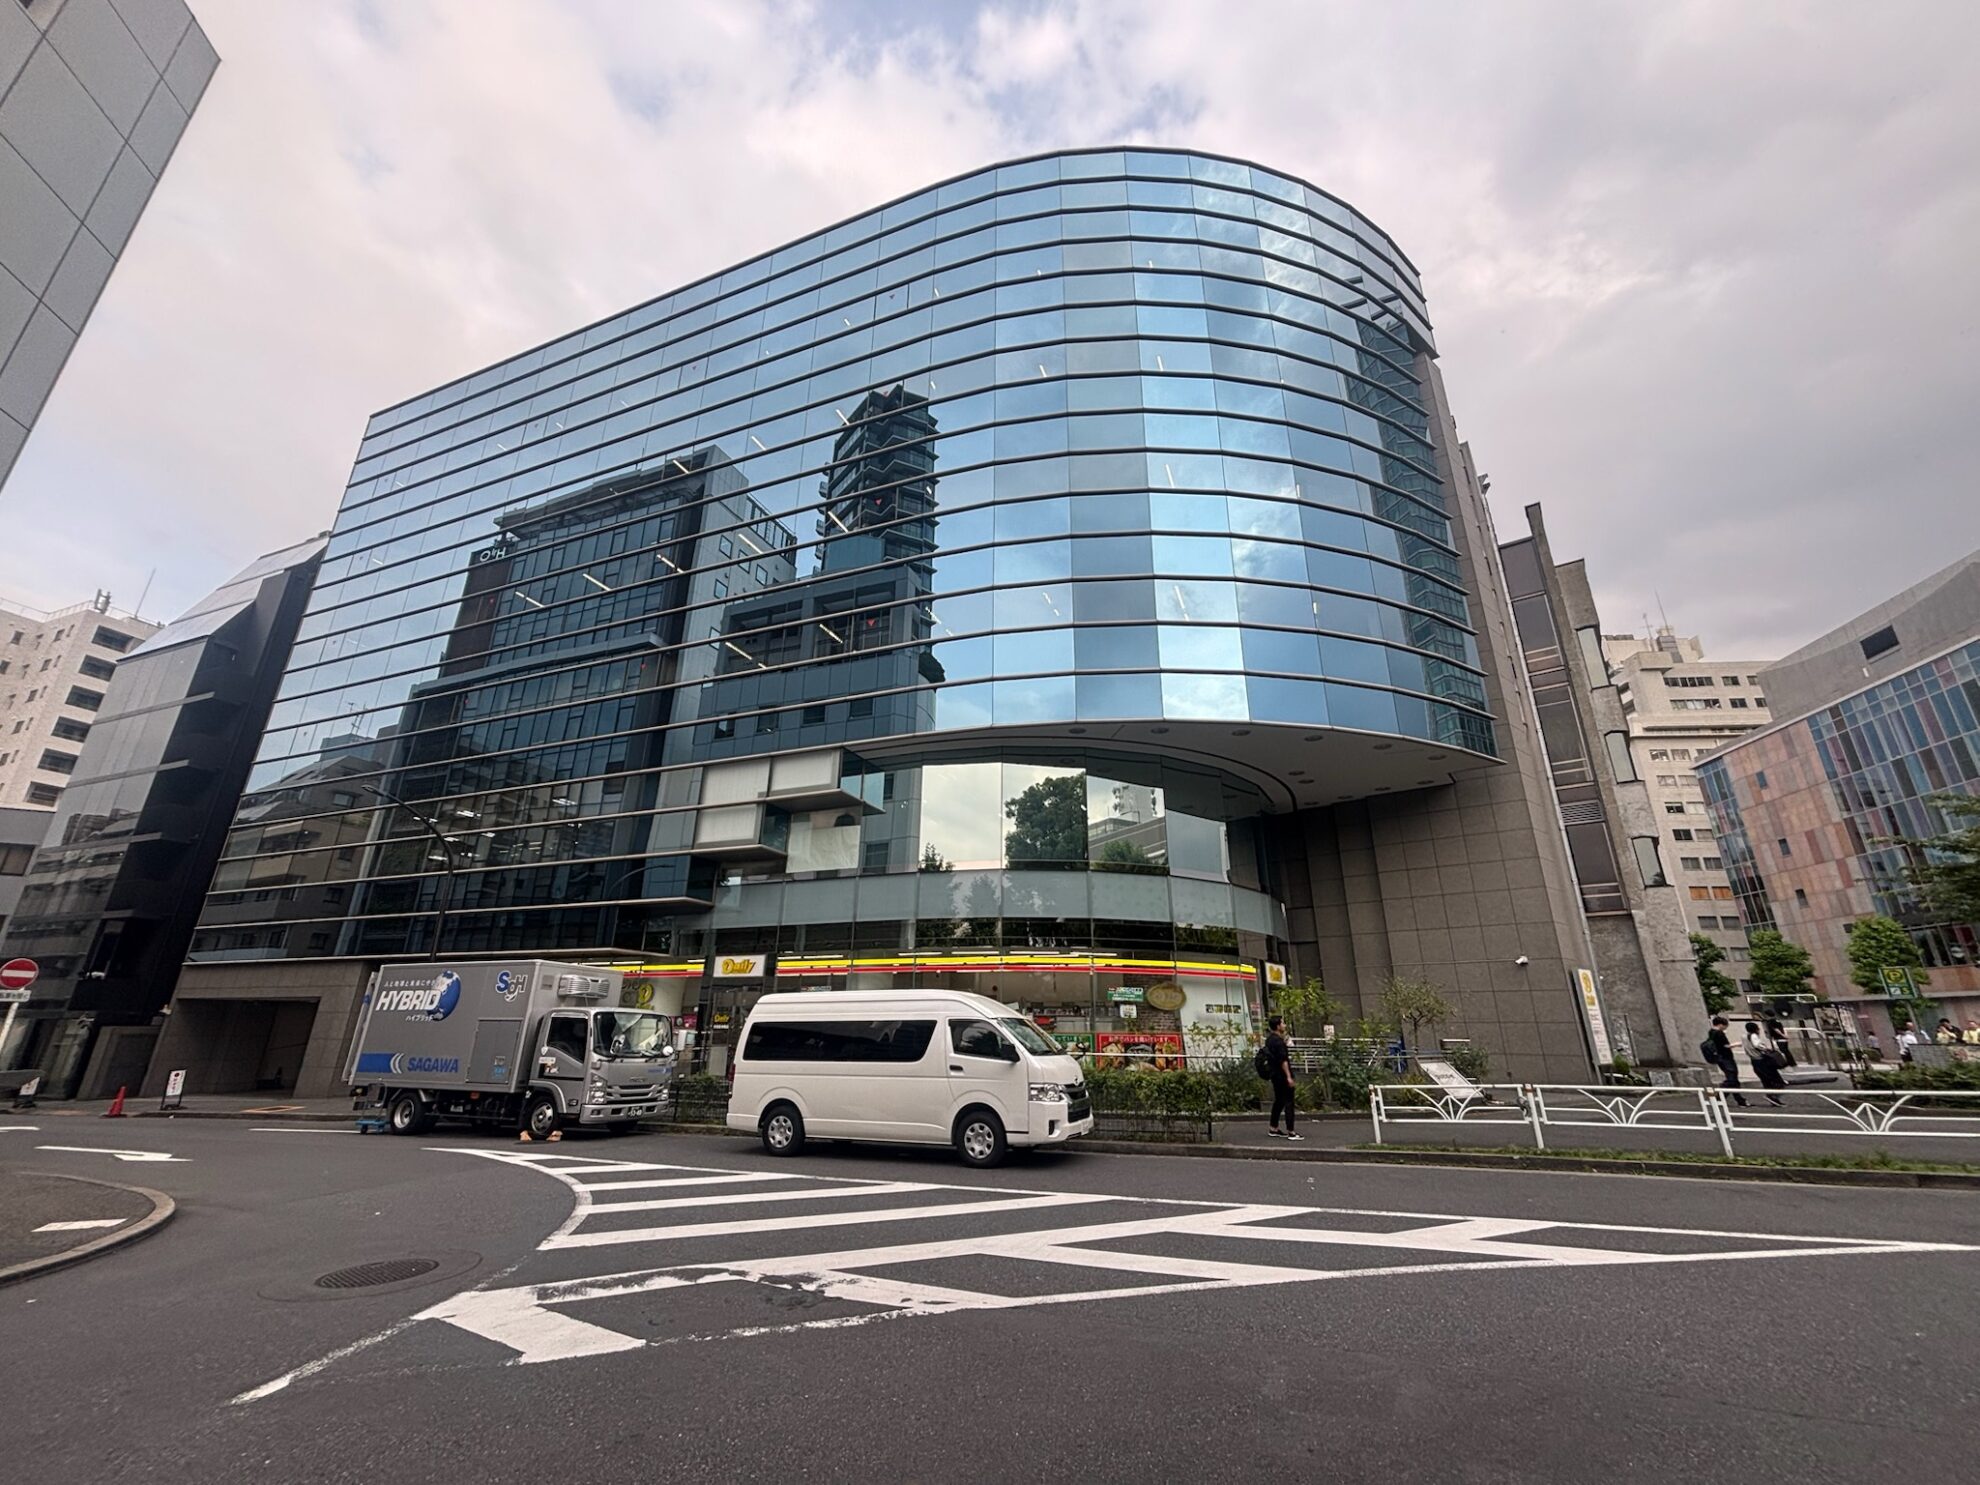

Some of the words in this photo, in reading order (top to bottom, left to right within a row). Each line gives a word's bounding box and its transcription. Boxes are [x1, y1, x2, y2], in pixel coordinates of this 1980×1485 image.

[722, 958, 757, 975] Daily
[375, 990, 441, 1011] HYBRID
[406, 1056, 459, 1073] SAGAWA
